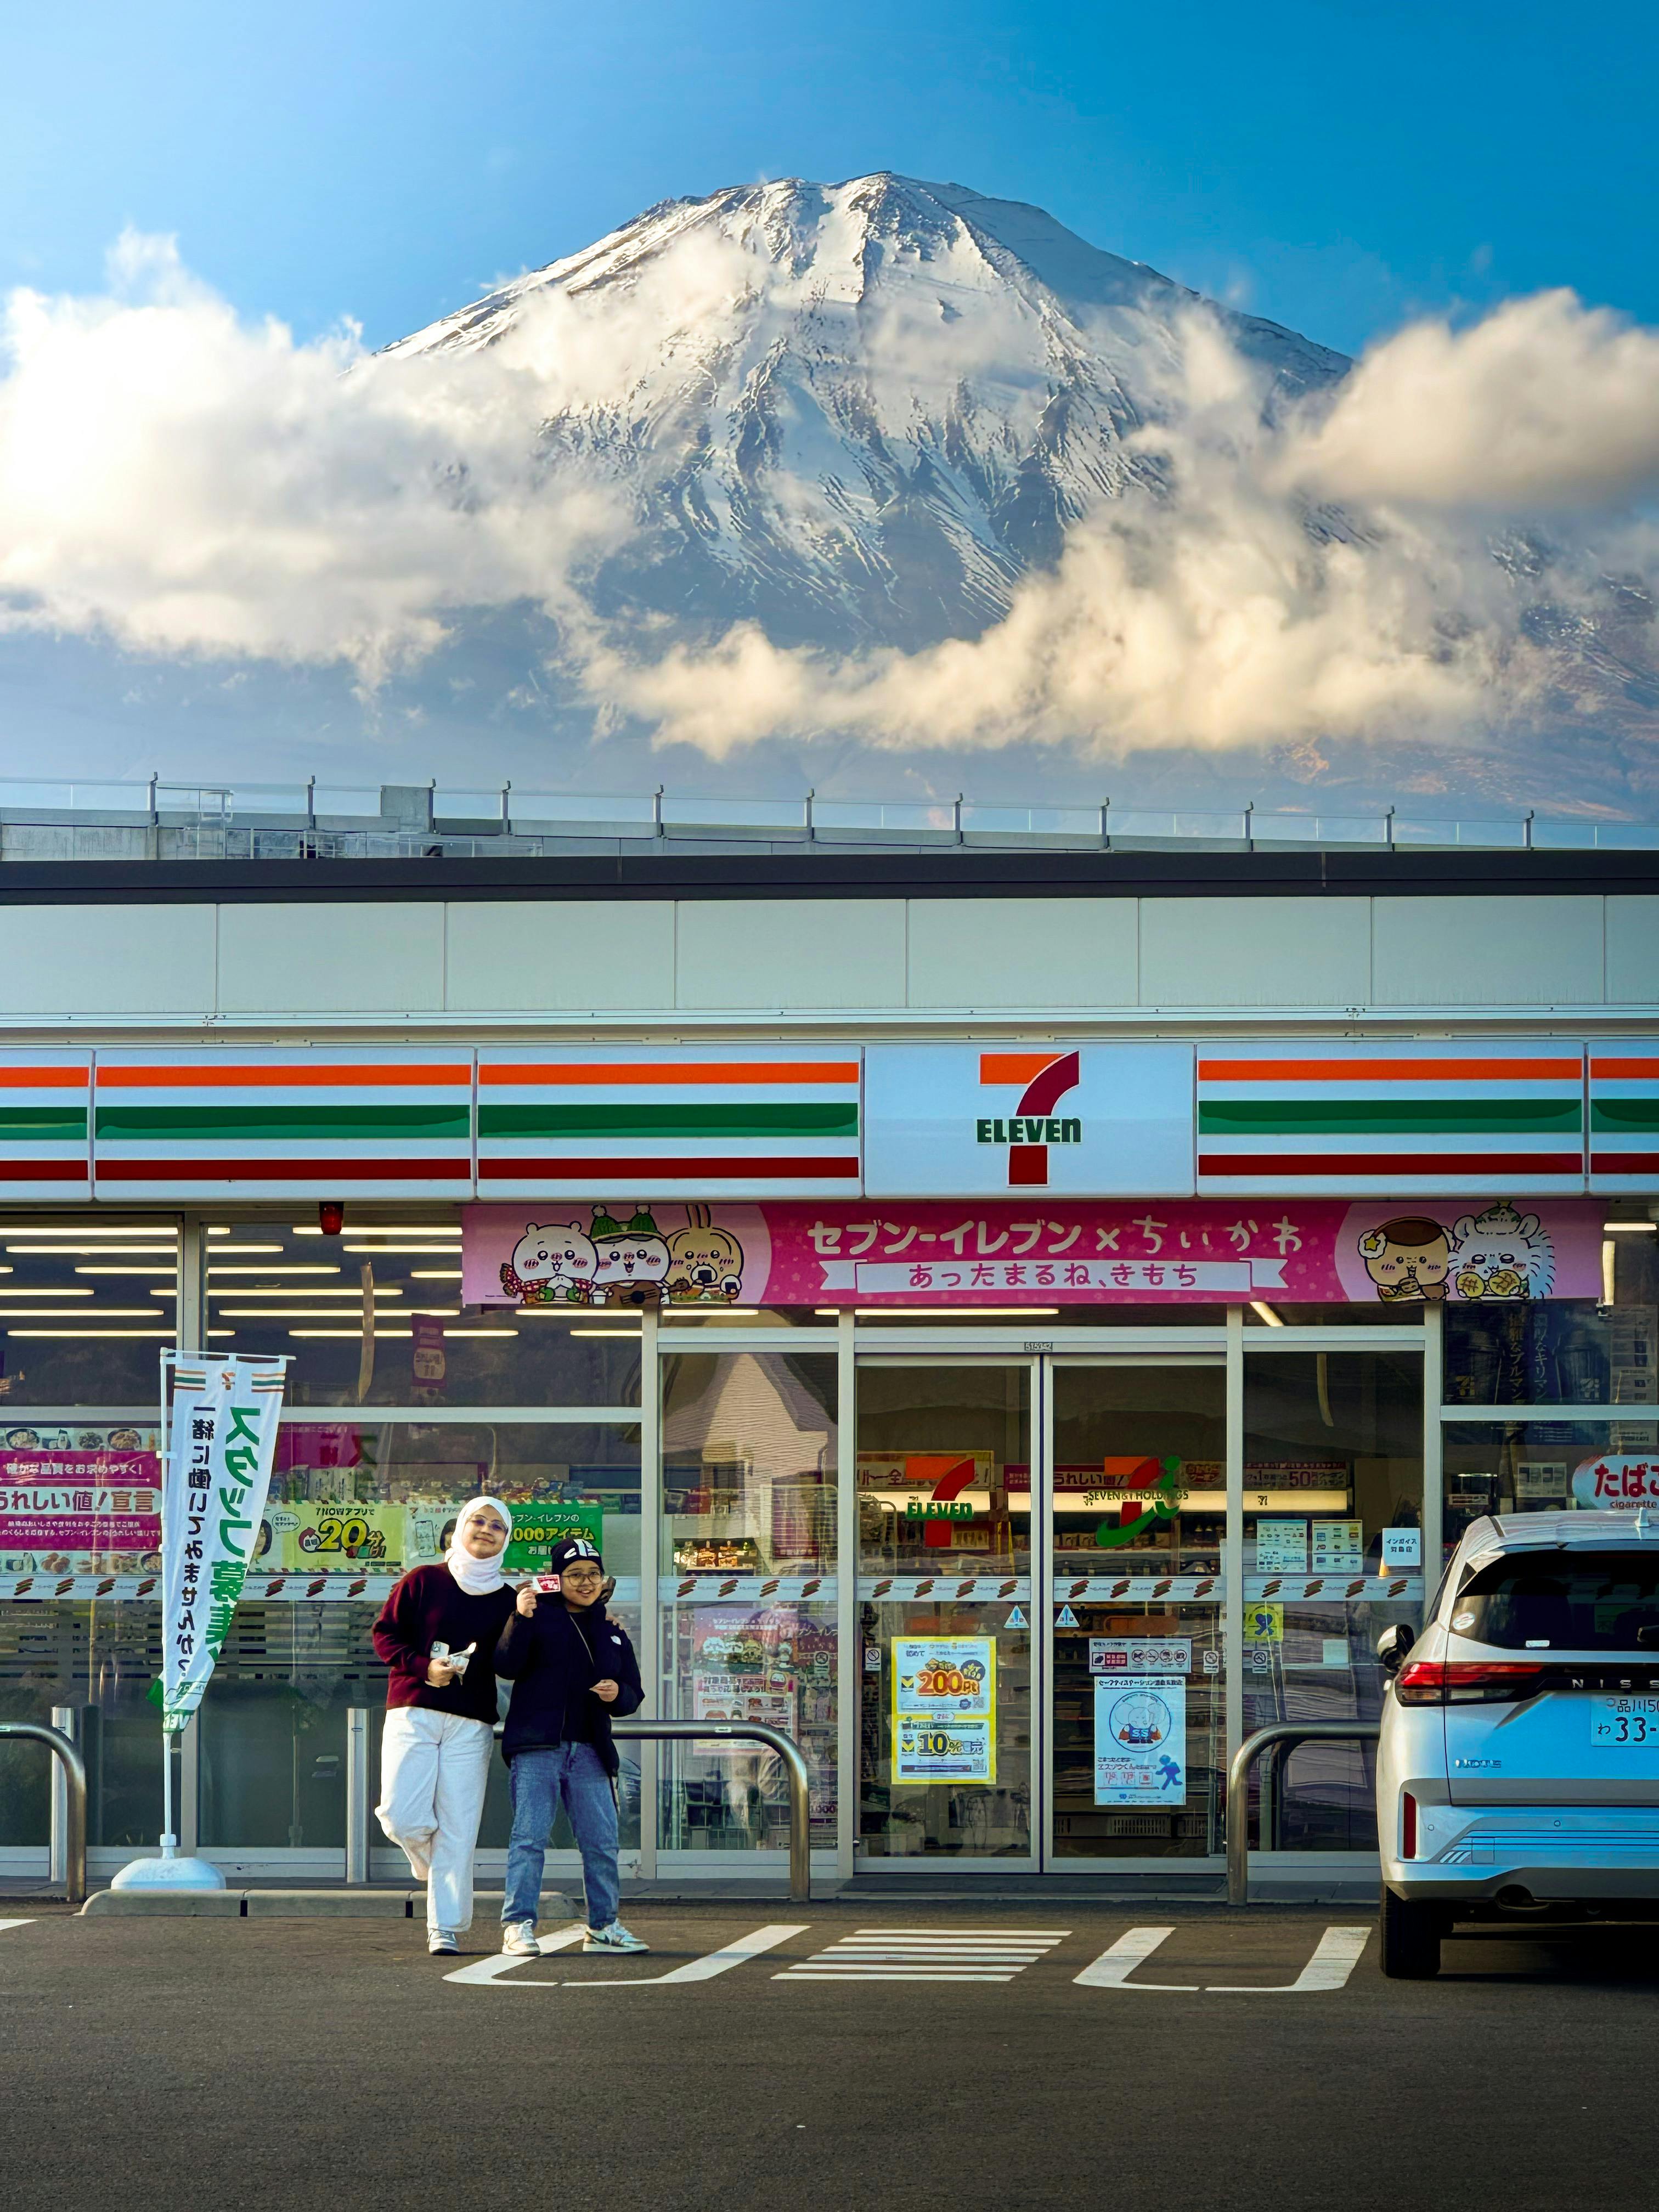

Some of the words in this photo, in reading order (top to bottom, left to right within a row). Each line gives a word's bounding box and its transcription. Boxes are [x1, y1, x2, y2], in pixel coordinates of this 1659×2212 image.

[909, 1263, 1198, 1289] あったまるね、きもち
[1598, 1723, 1611, 1735] わ
